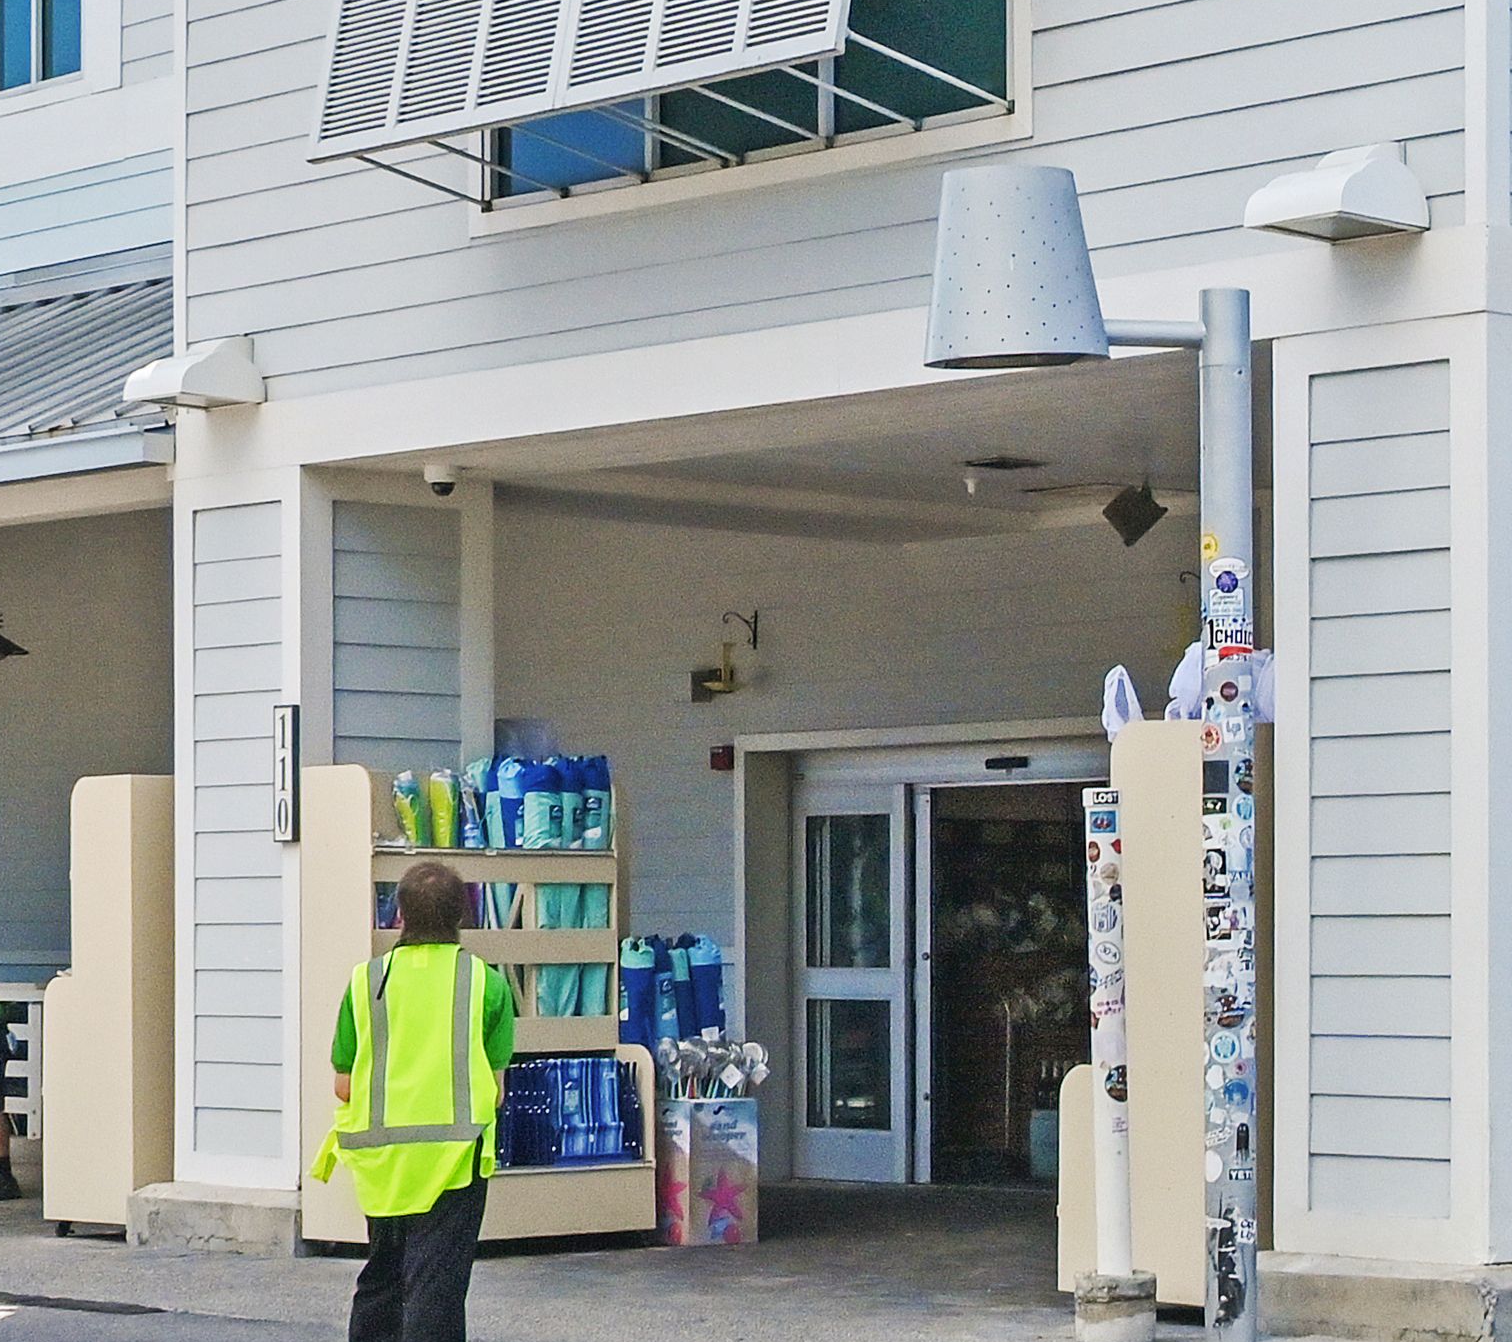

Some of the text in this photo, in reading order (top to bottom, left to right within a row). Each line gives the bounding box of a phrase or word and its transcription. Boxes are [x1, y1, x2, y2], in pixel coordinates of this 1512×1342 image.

[1215, 629, 1253, 646] CHOIC
[277, 713, 289, 835] 110
[1094, 792, 1118, 804] LOST
